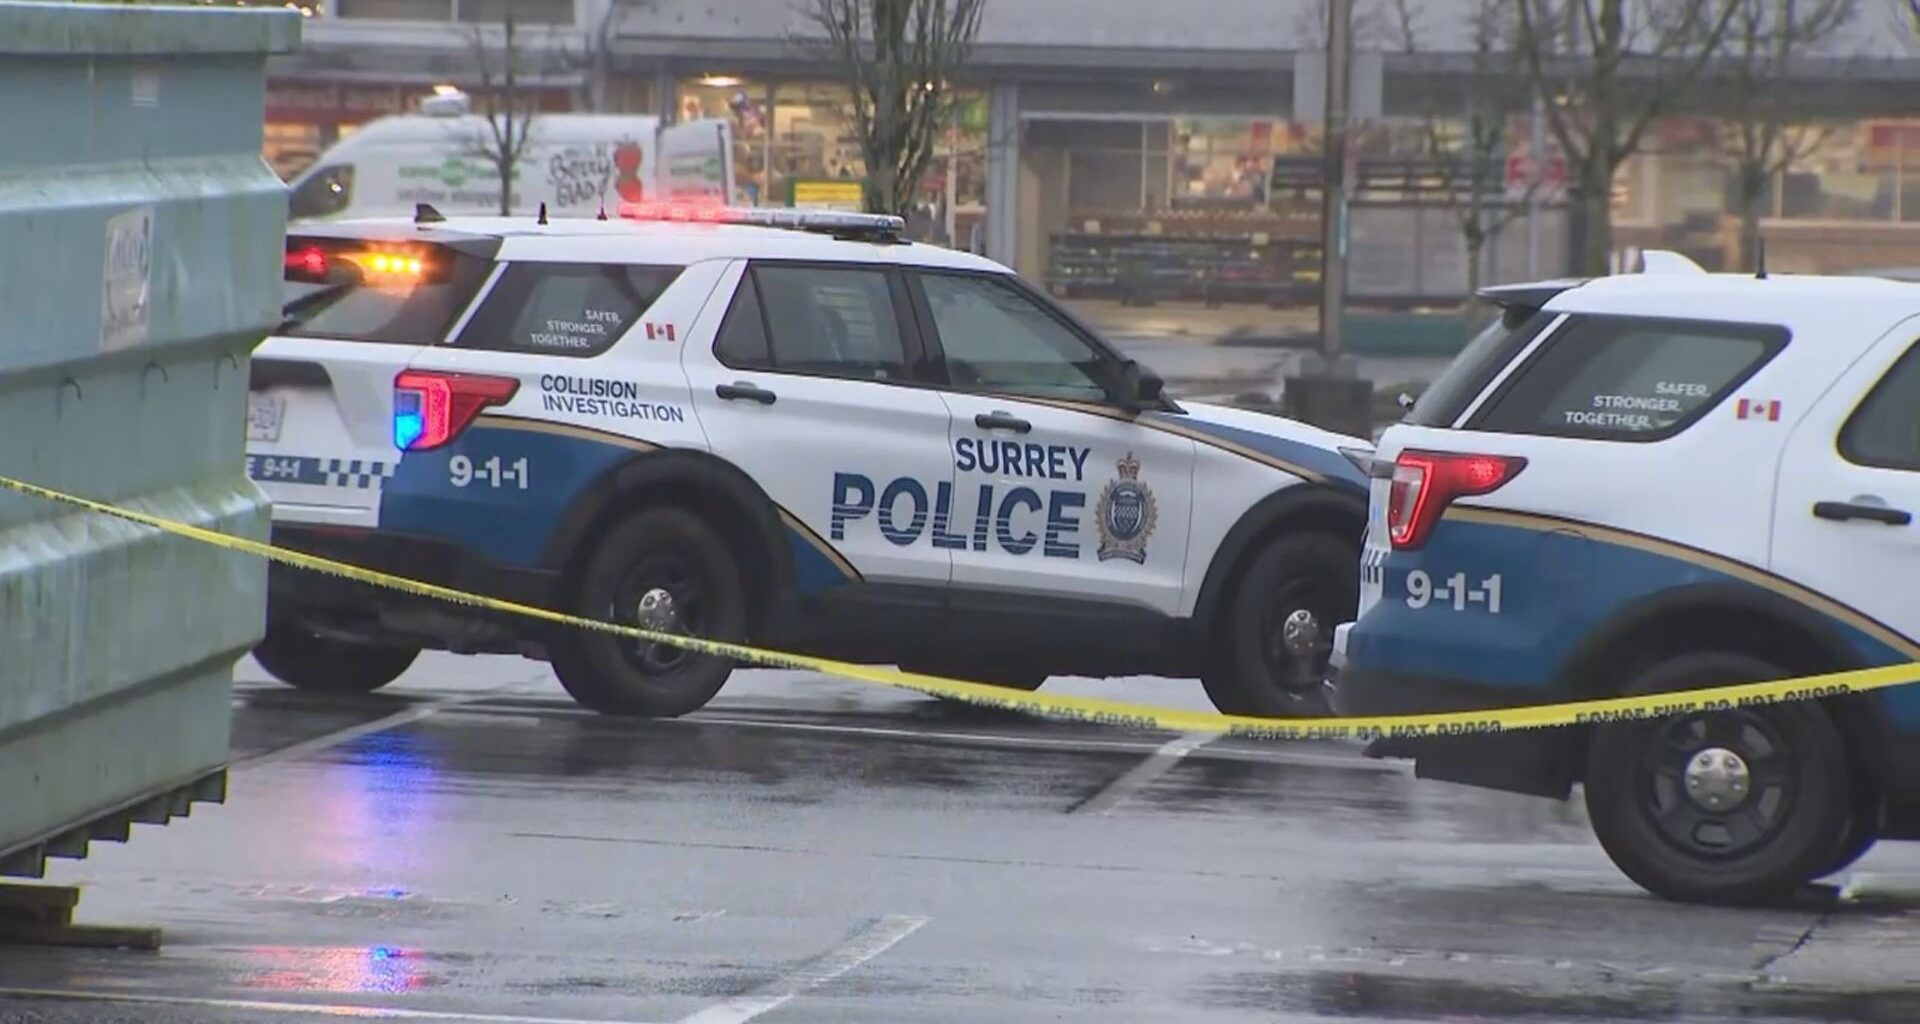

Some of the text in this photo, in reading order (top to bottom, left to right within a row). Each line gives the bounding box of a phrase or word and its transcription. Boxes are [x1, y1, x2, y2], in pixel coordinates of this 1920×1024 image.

[540, 373, 638, 400] COLLISION
[543, 396, 685, 423] INVESTIGATION
[262, 457, 301, 478] 9-1-1
[449, 455, 529, 489] 9-1-1
[955, 437, 1091, 481] SURREY
[830, 471, 1087, 559] POLICE
[1406, 569, 1503, 614] 9-1-1
